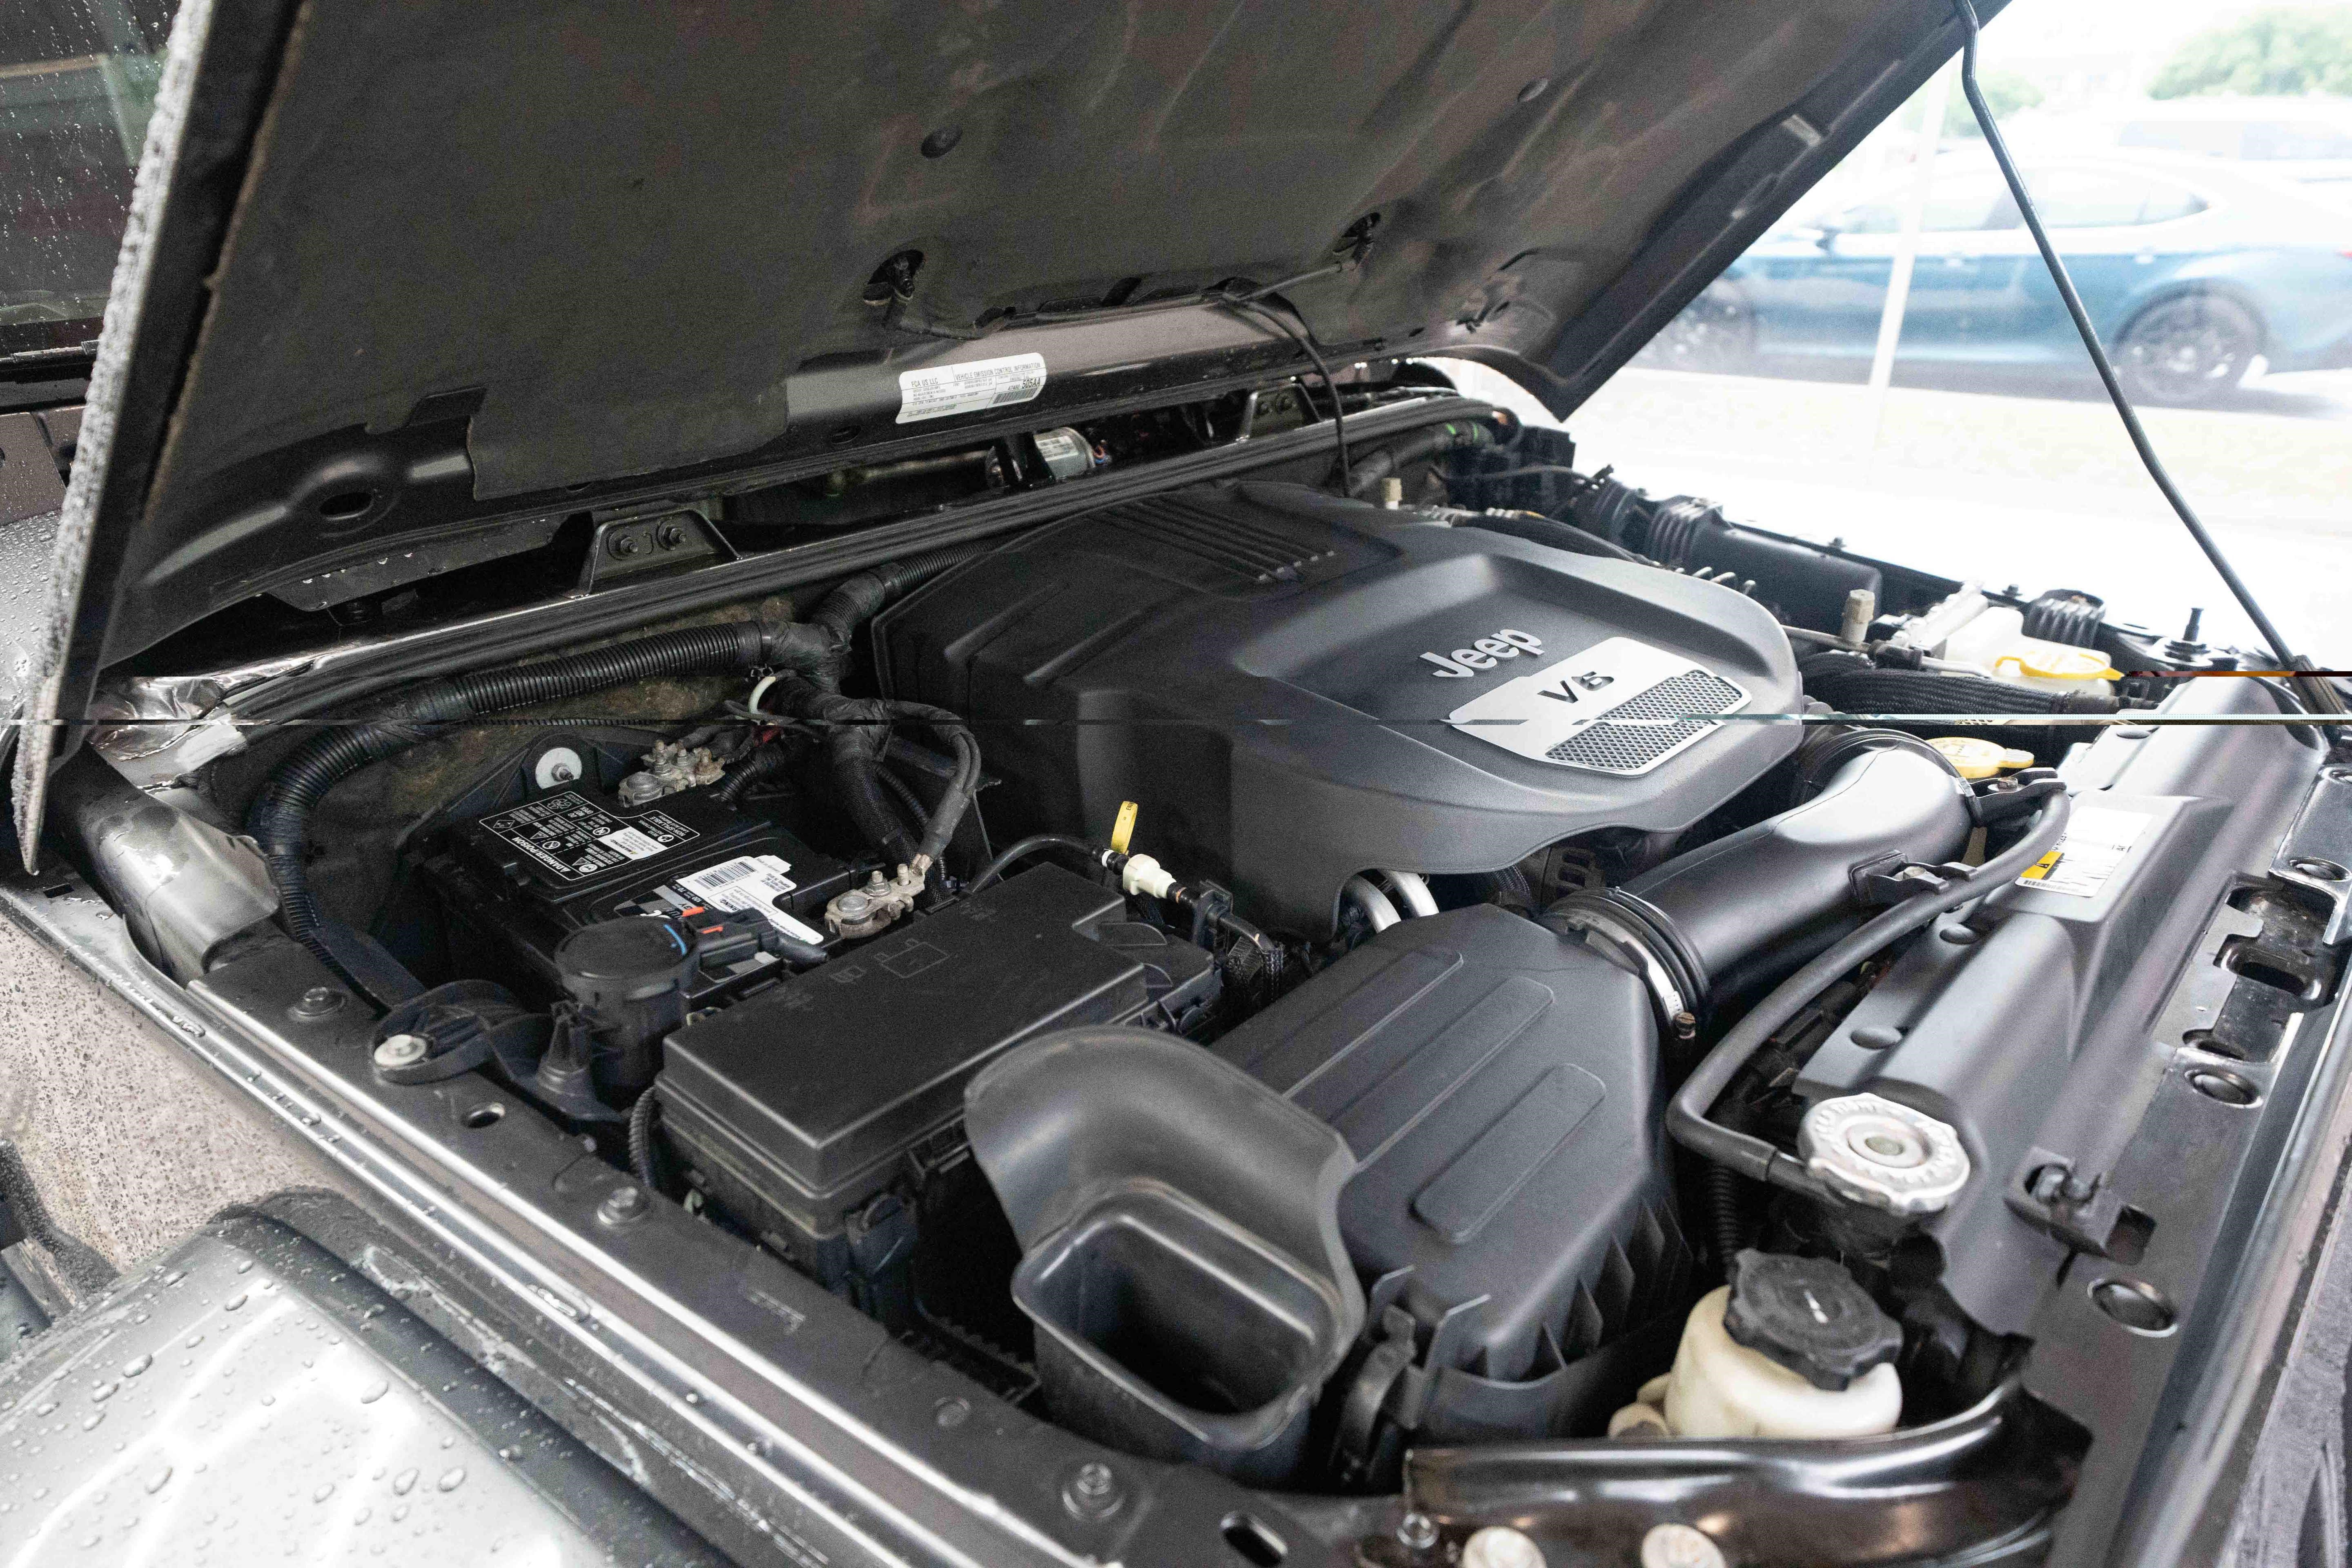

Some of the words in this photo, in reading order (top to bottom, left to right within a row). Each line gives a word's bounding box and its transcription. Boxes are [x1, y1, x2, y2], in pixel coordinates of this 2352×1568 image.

[955, 371, 973, 381] VEHICLE
[973, 368, 993, 378] EMISSION
[993, 365, 1013, 375] CONTROL
[1013, 361, 1040, 372] INFORMATION
[911, 380, 921, 388] FCA
[929, 377, 938, 385] LLC
[1419, 629, 1545, 677] Jeep
[1537, 671, 1614, 703] V6
[648, 815, 686, 836] NON-SPILLABLE
[510, 836, 566, 870] DANGER/POISON
[717, 898, 741, 912] RNING:
